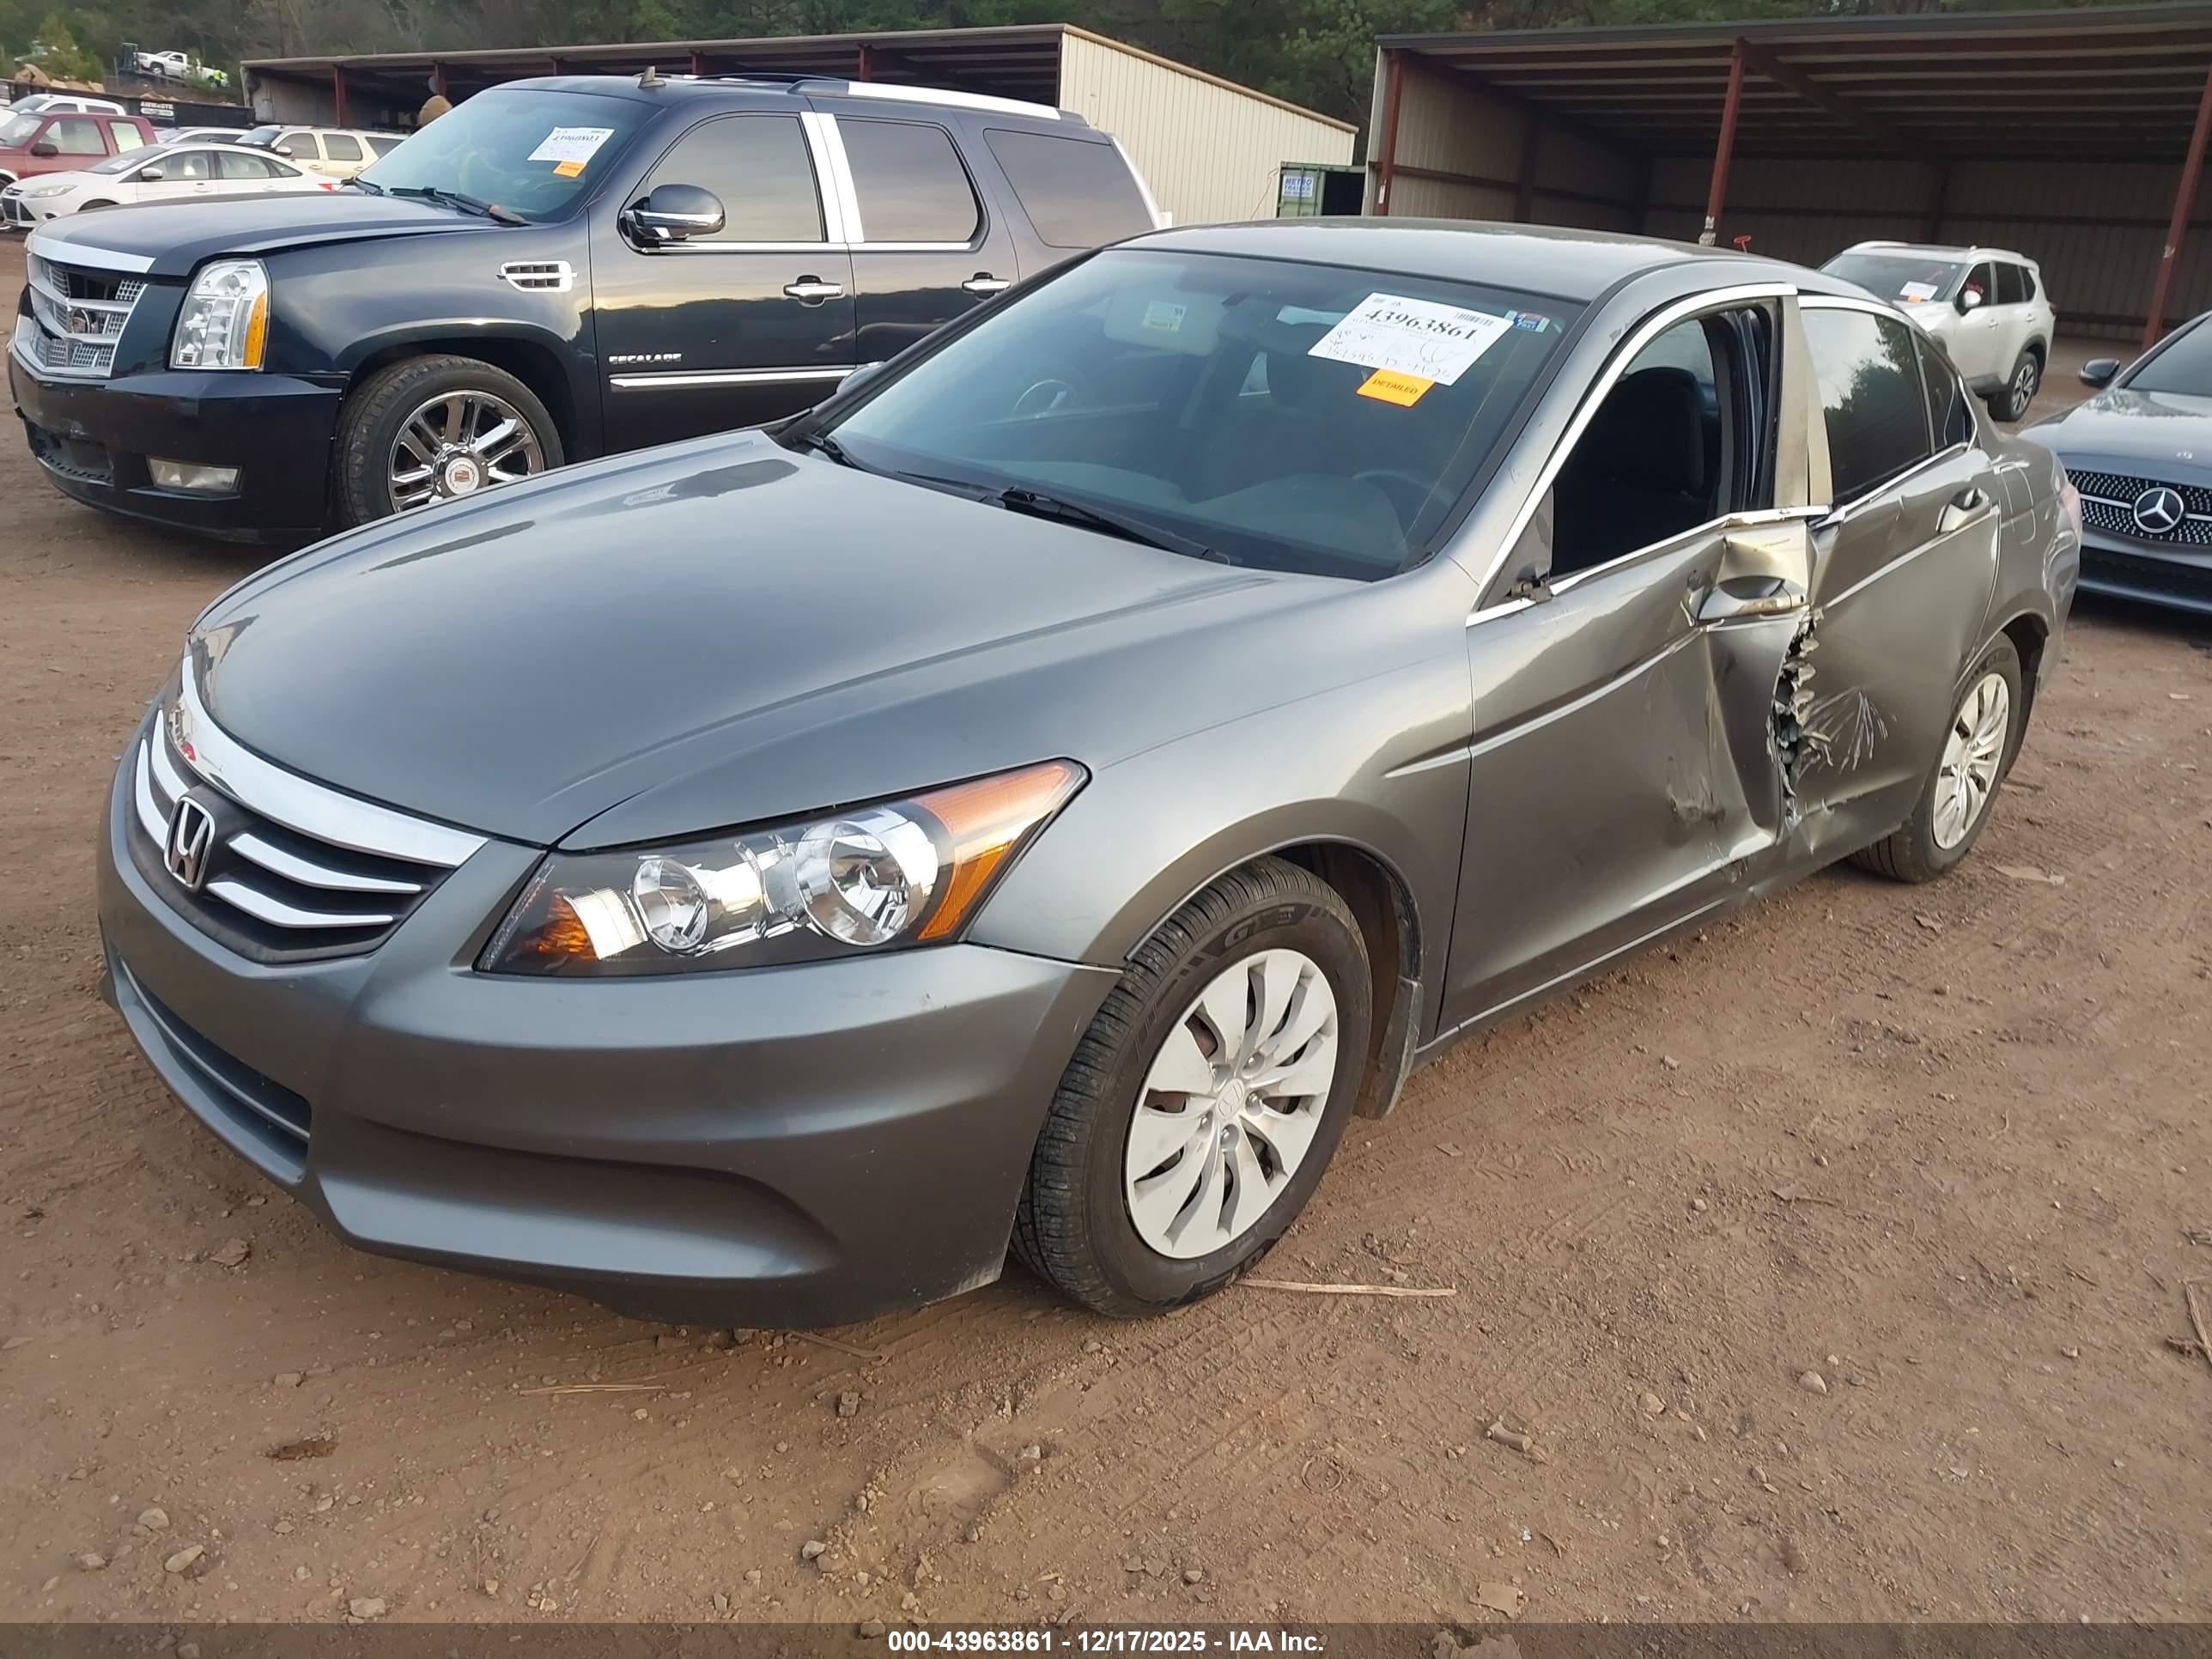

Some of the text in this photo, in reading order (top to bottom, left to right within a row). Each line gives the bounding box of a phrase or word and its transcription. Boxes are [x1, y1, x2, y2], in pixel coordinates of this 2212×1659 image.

[1364, 308, 1478, 340] 43963861
[609, 353, 682, 365] ESCALADE
[1372, 379, 1419, 394] DETAILED
